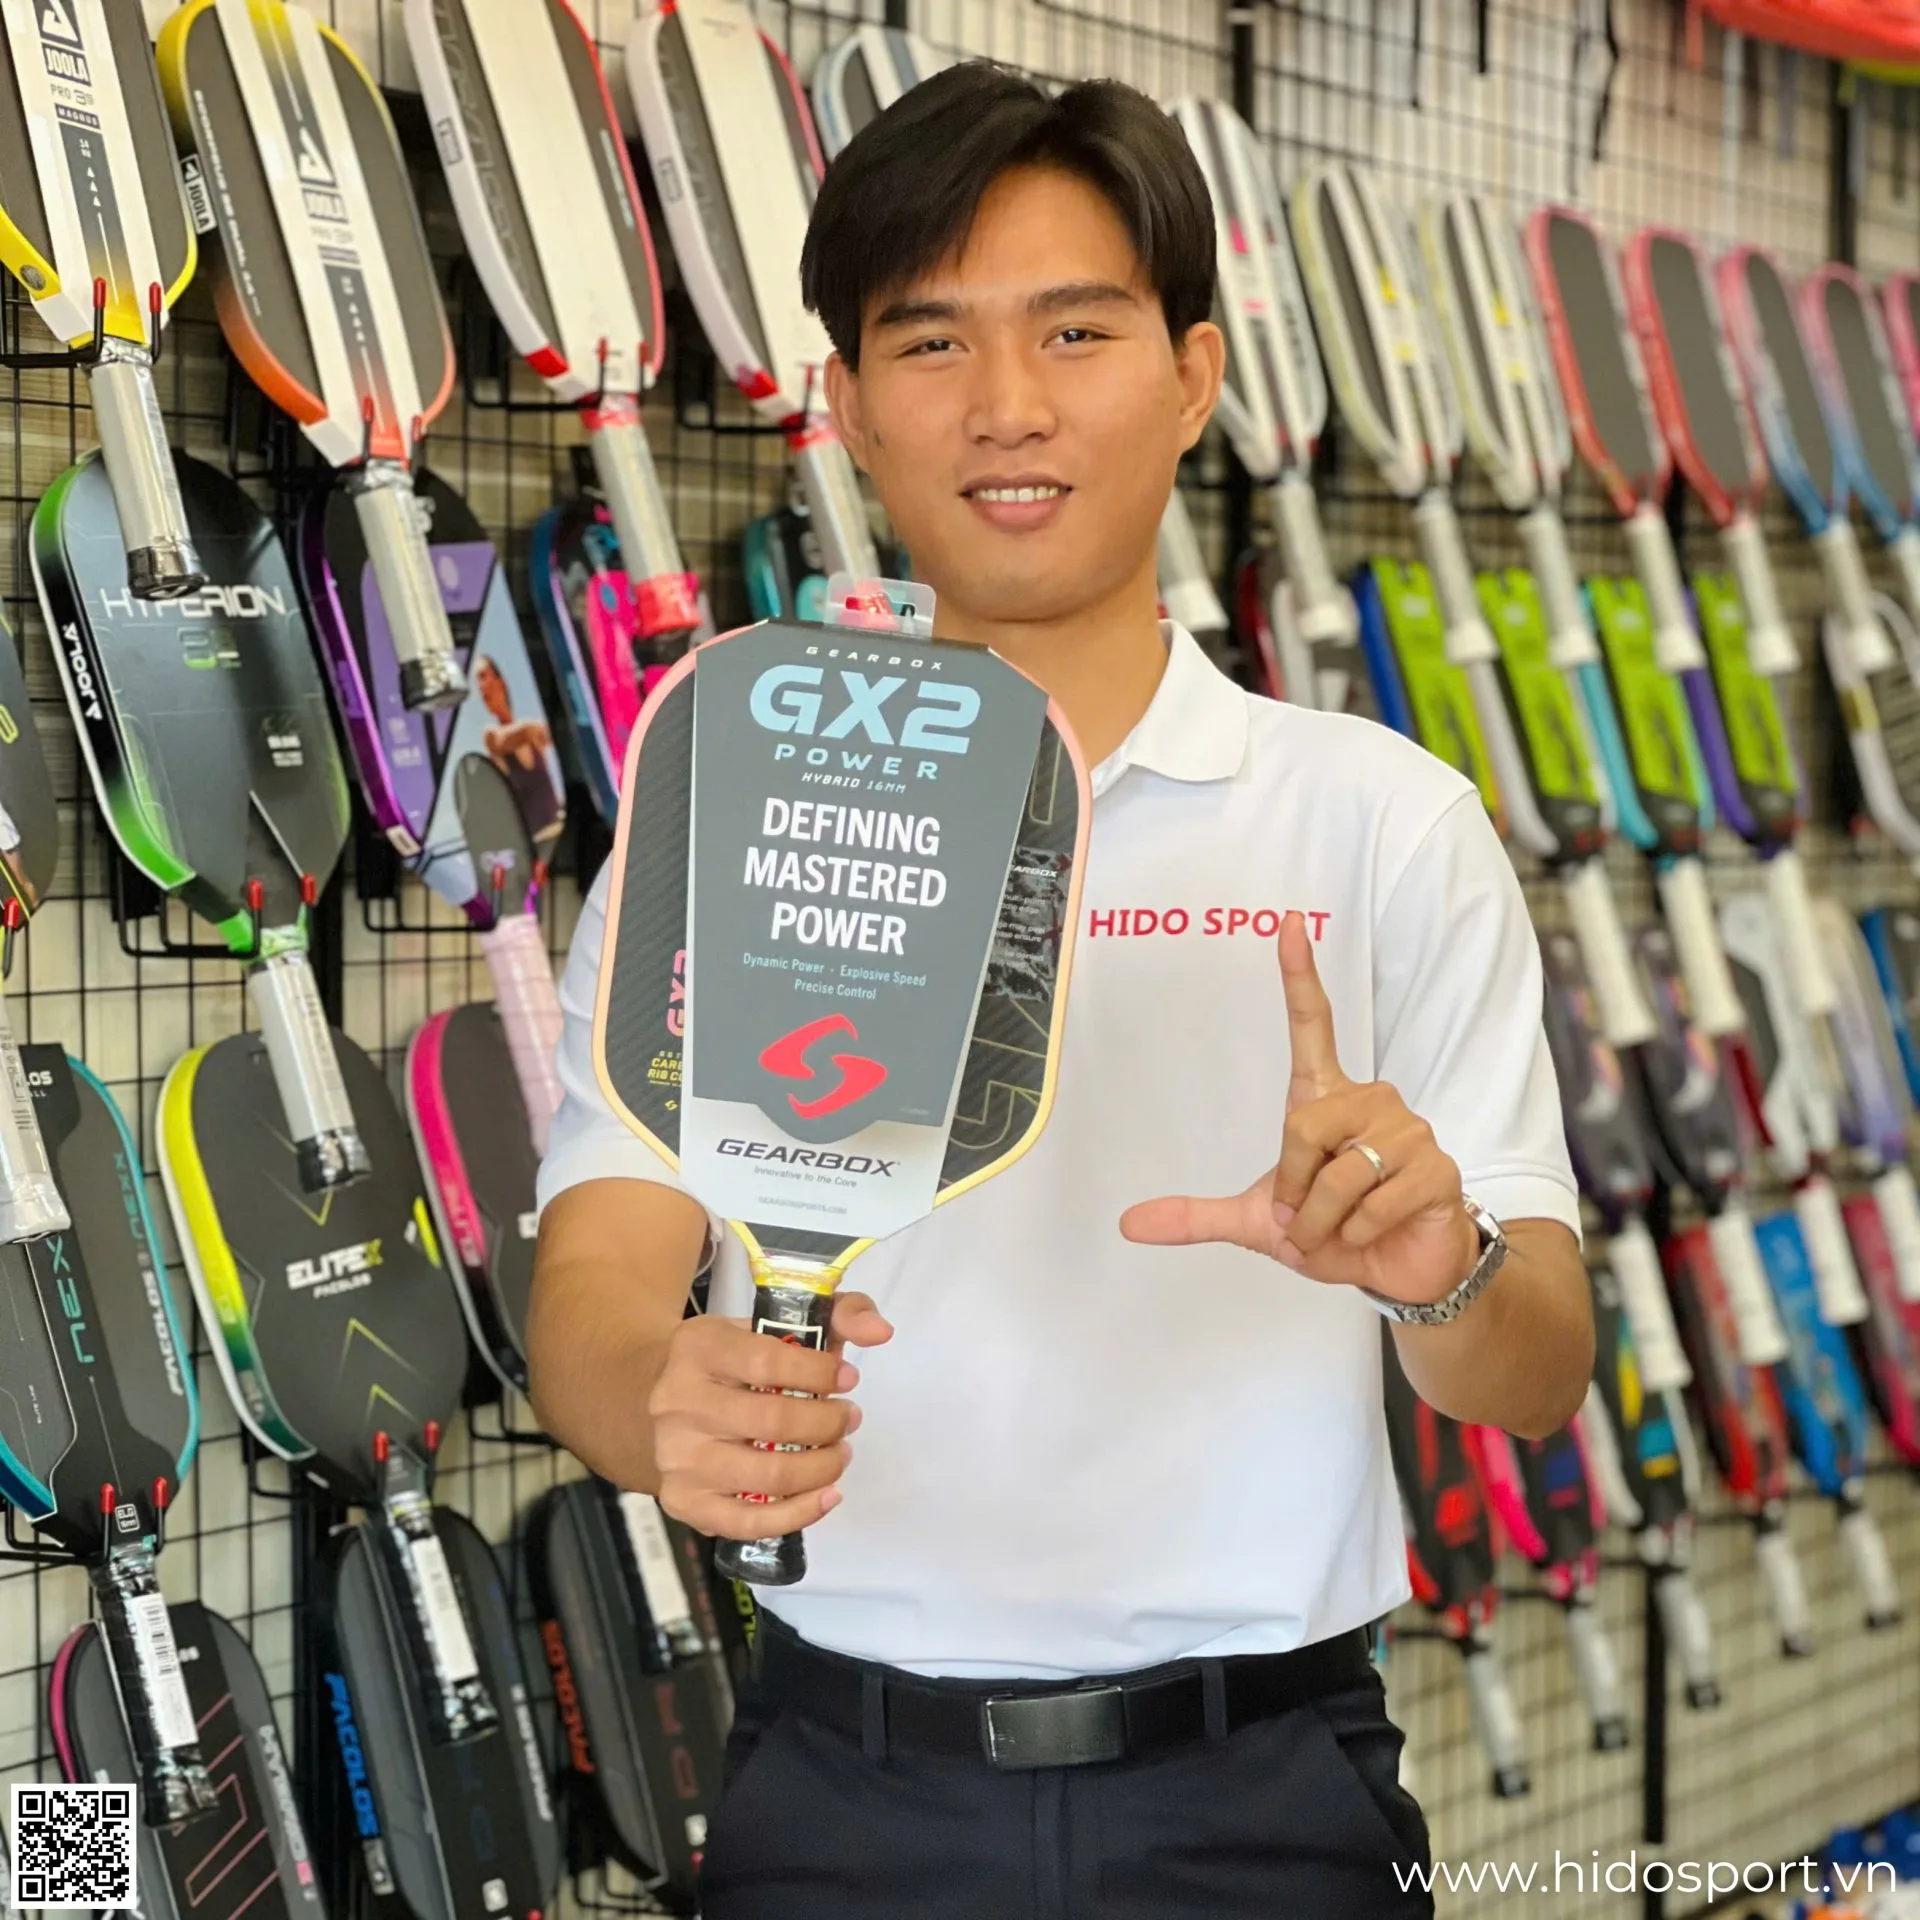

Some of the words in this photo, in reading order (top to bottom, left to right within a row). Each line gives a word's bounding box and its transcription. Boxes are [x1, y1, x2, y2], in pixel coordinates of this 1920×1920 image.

[44, 47, 89, 82] JOOLA
[188, 181, 211, 229] JOOLA
[63, 622, 97, 700] JOOLA
[805, 646, 943, 671] GEARBOX
[750, 664, 982, 754] GX2
[774, 743, 939, 780] POWER
[801, 772, 861, 788] HYBRID
[866, 780, 907, 794] 16MM
[762, 797, 941, 856] DEFINING
[743, 846, 948, 907] MASTERED
[1009, 865, 1058, 878] ARBOX
[770, 901, 907, 955] POWER
[1089, 908, 1189, 937] HIDO
[1203, 908, 1331, 941] SPOT
[743, 952, 789, 970] Dynamic
[791, 958, 825, 974] Power
[840, 964, 891, 983] Explosive
[892, 972, 927, 988] Speed
[794, 979, 834, 994] Precise
[837, 984, 877, 1000] Control
[716, 1138, 895, 1177] GEARBOX
[754, 1166, 801, 1180] Innovative
[804, 1173, 814, 1182] to
[816, 1174, 832, 1184] the
[834, 1177, 857, 1188] Core
